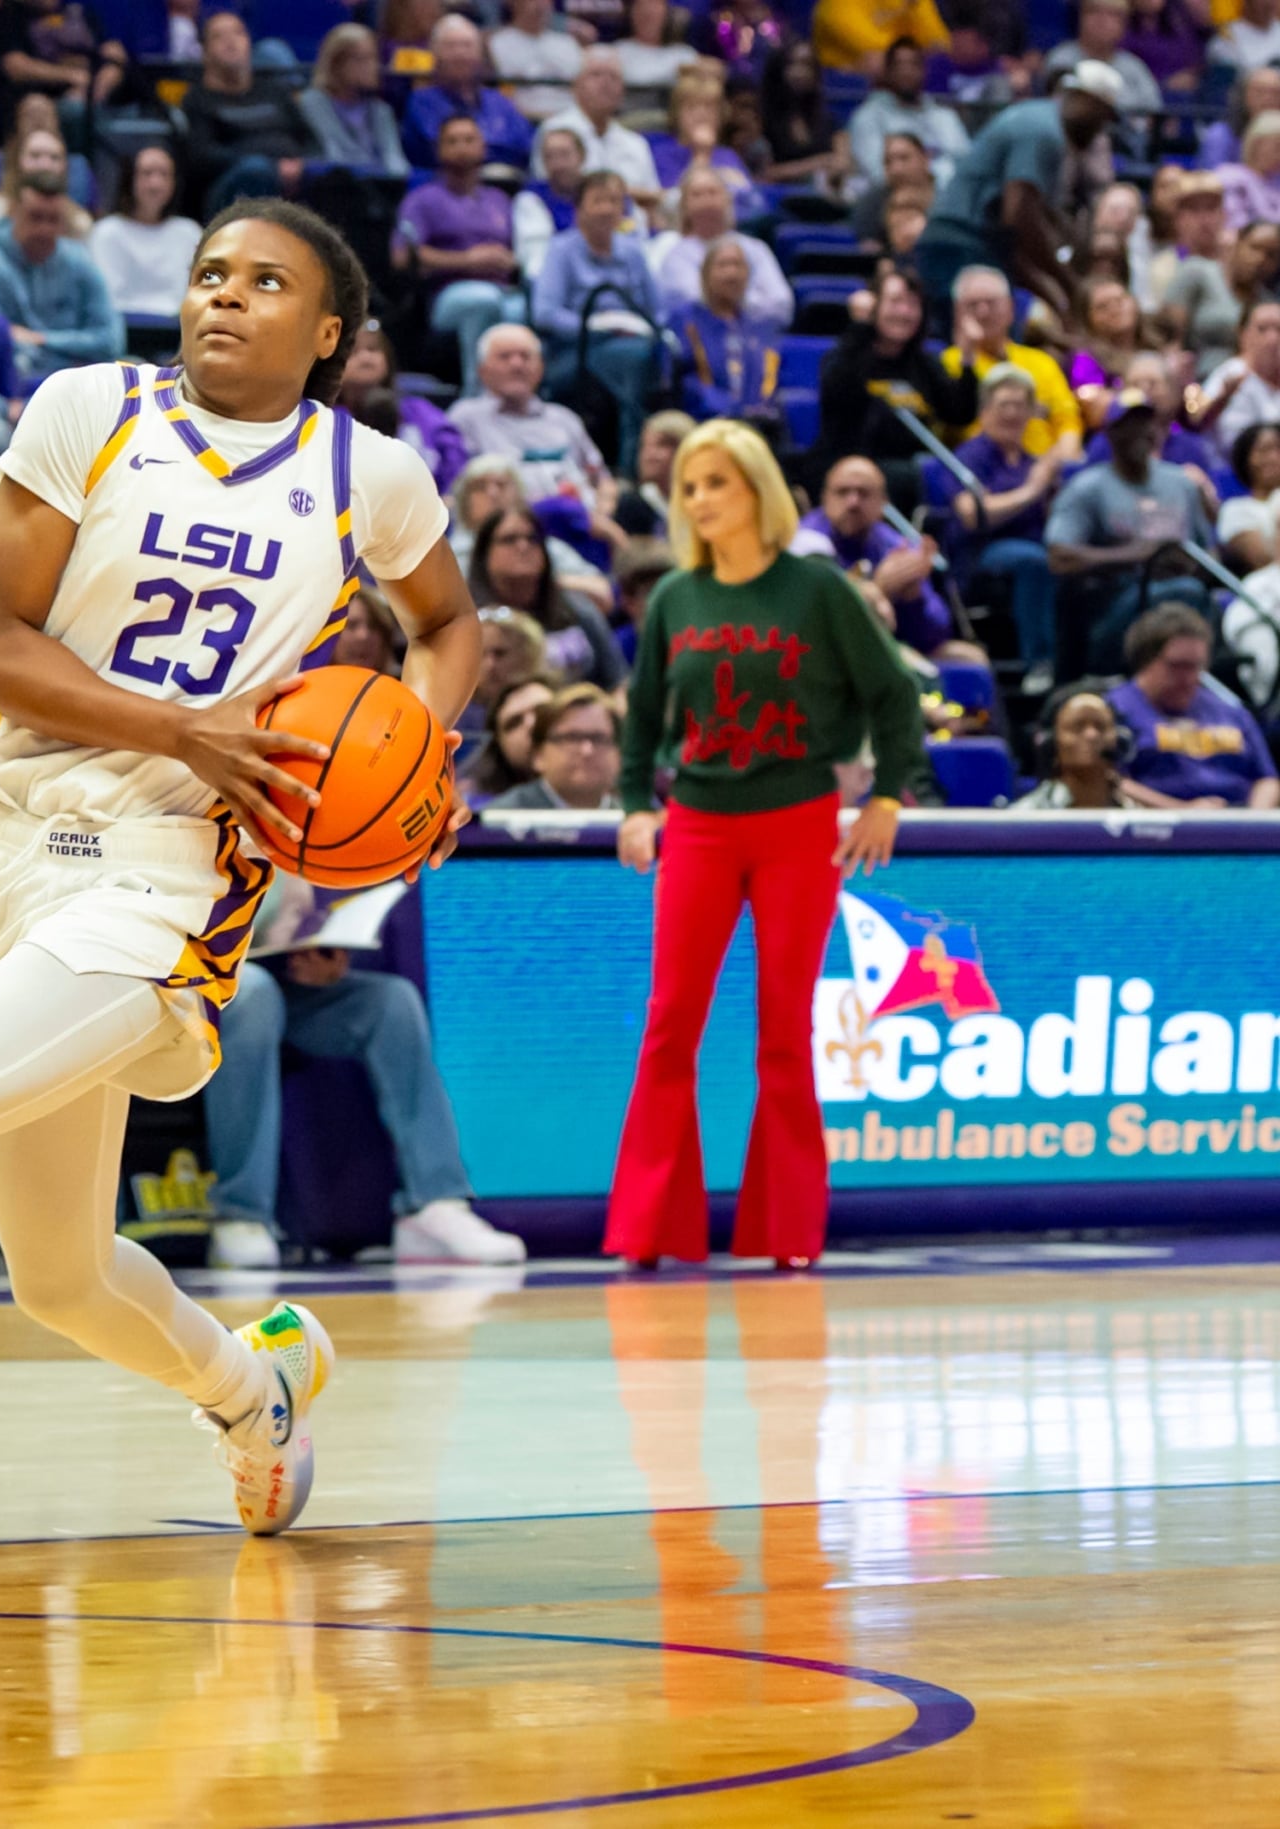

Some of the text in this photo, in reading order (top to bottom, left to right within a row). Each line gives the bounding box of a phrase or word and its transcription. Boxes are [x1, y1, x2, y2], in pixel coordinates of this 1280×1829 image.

[291, 489, 315, 515] SEC
[139, 512, 282, 580] LSU
[110, 577, 257, 695] 23
[401, 765, 451, 842] ELIT
[46, 844, 102, 858] TIGERS
[49, 832, 100, 845] GEAUX
[825, 1109, 1096, 1163] mbulance
